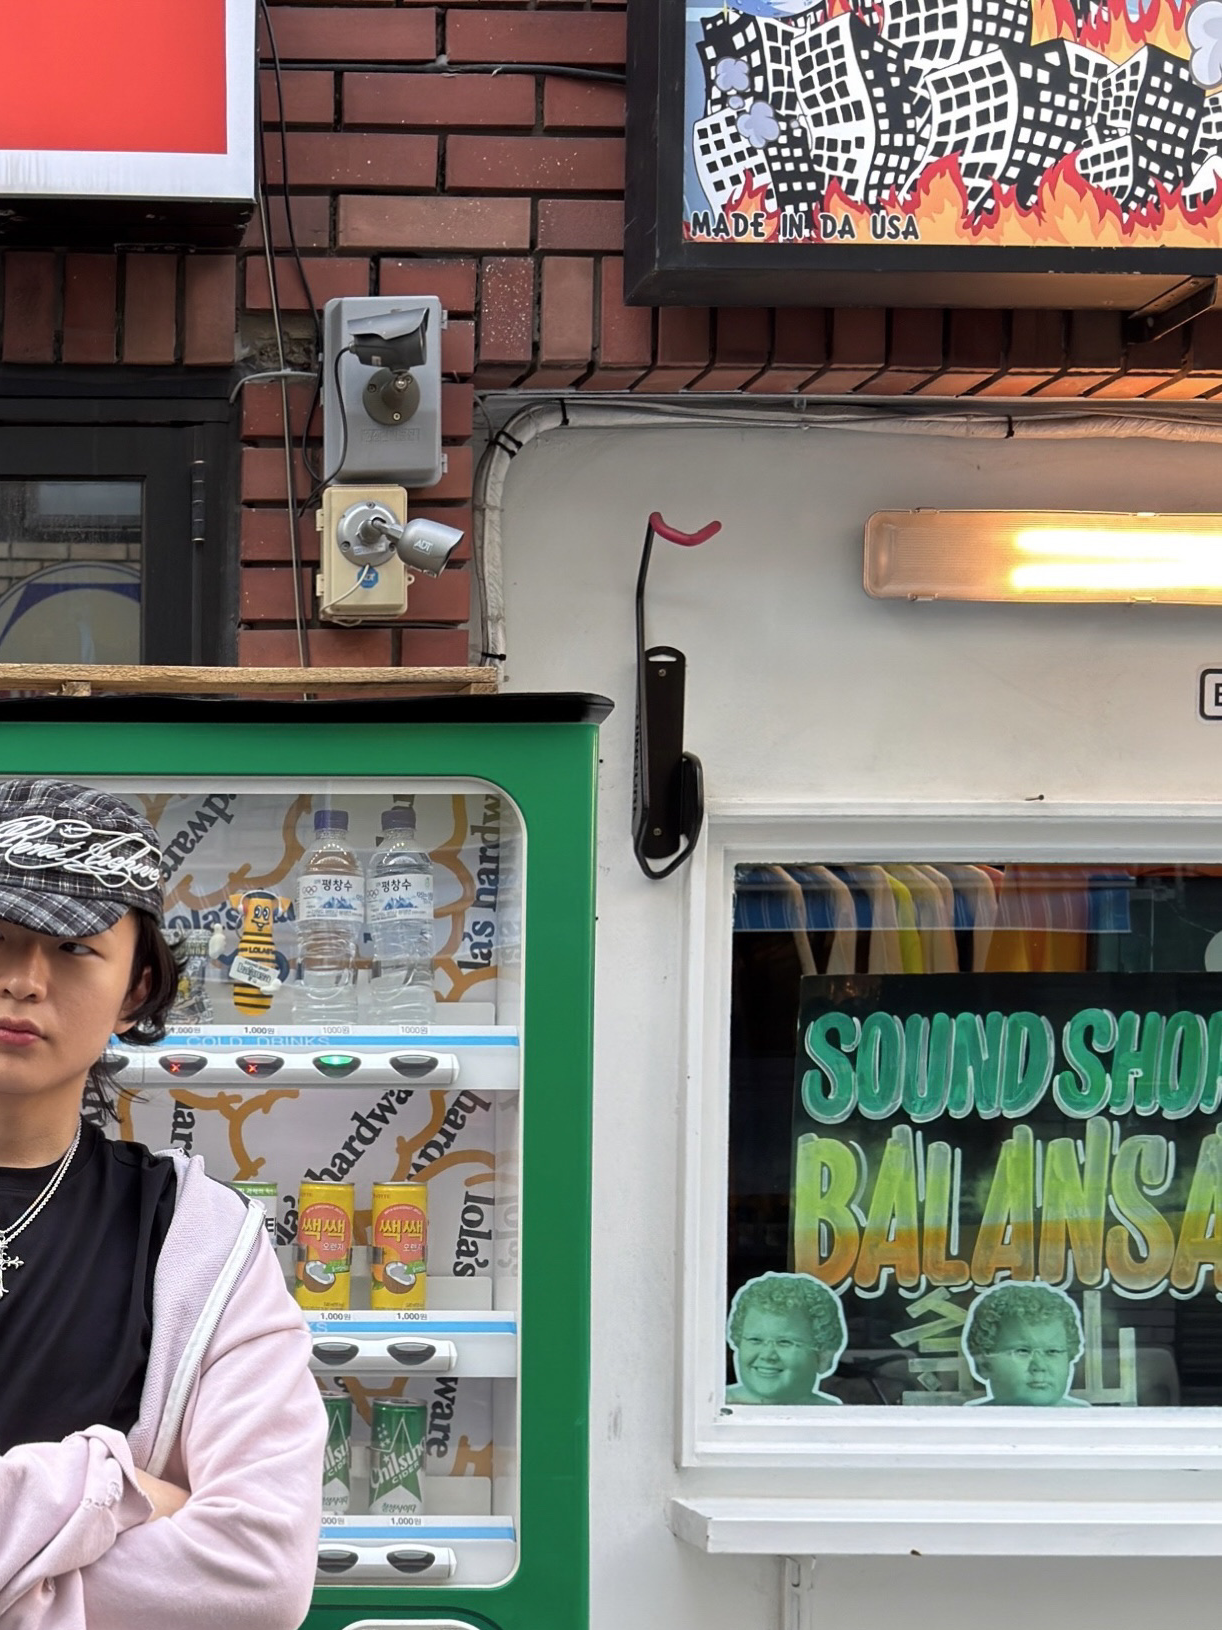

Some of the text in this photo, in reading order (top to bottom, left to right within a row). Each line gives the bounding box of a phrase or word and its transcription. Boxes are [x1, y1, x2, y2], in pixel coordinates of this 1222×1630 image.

[691, 211, 919, 241] MADE IN DA USA
[321, 879, 353, 891] 평창수
[381, 879, 412, 892] 평창수
[323, 1026, 350, 1034] 1000원
[401, 1026, 428, 1034] 1000원
[186, 1036, 330, 1046] COLD DRINKS
[802, 1011, 1055, 1125] SOUND
[392, 1461, 420, 1484] CIDER
